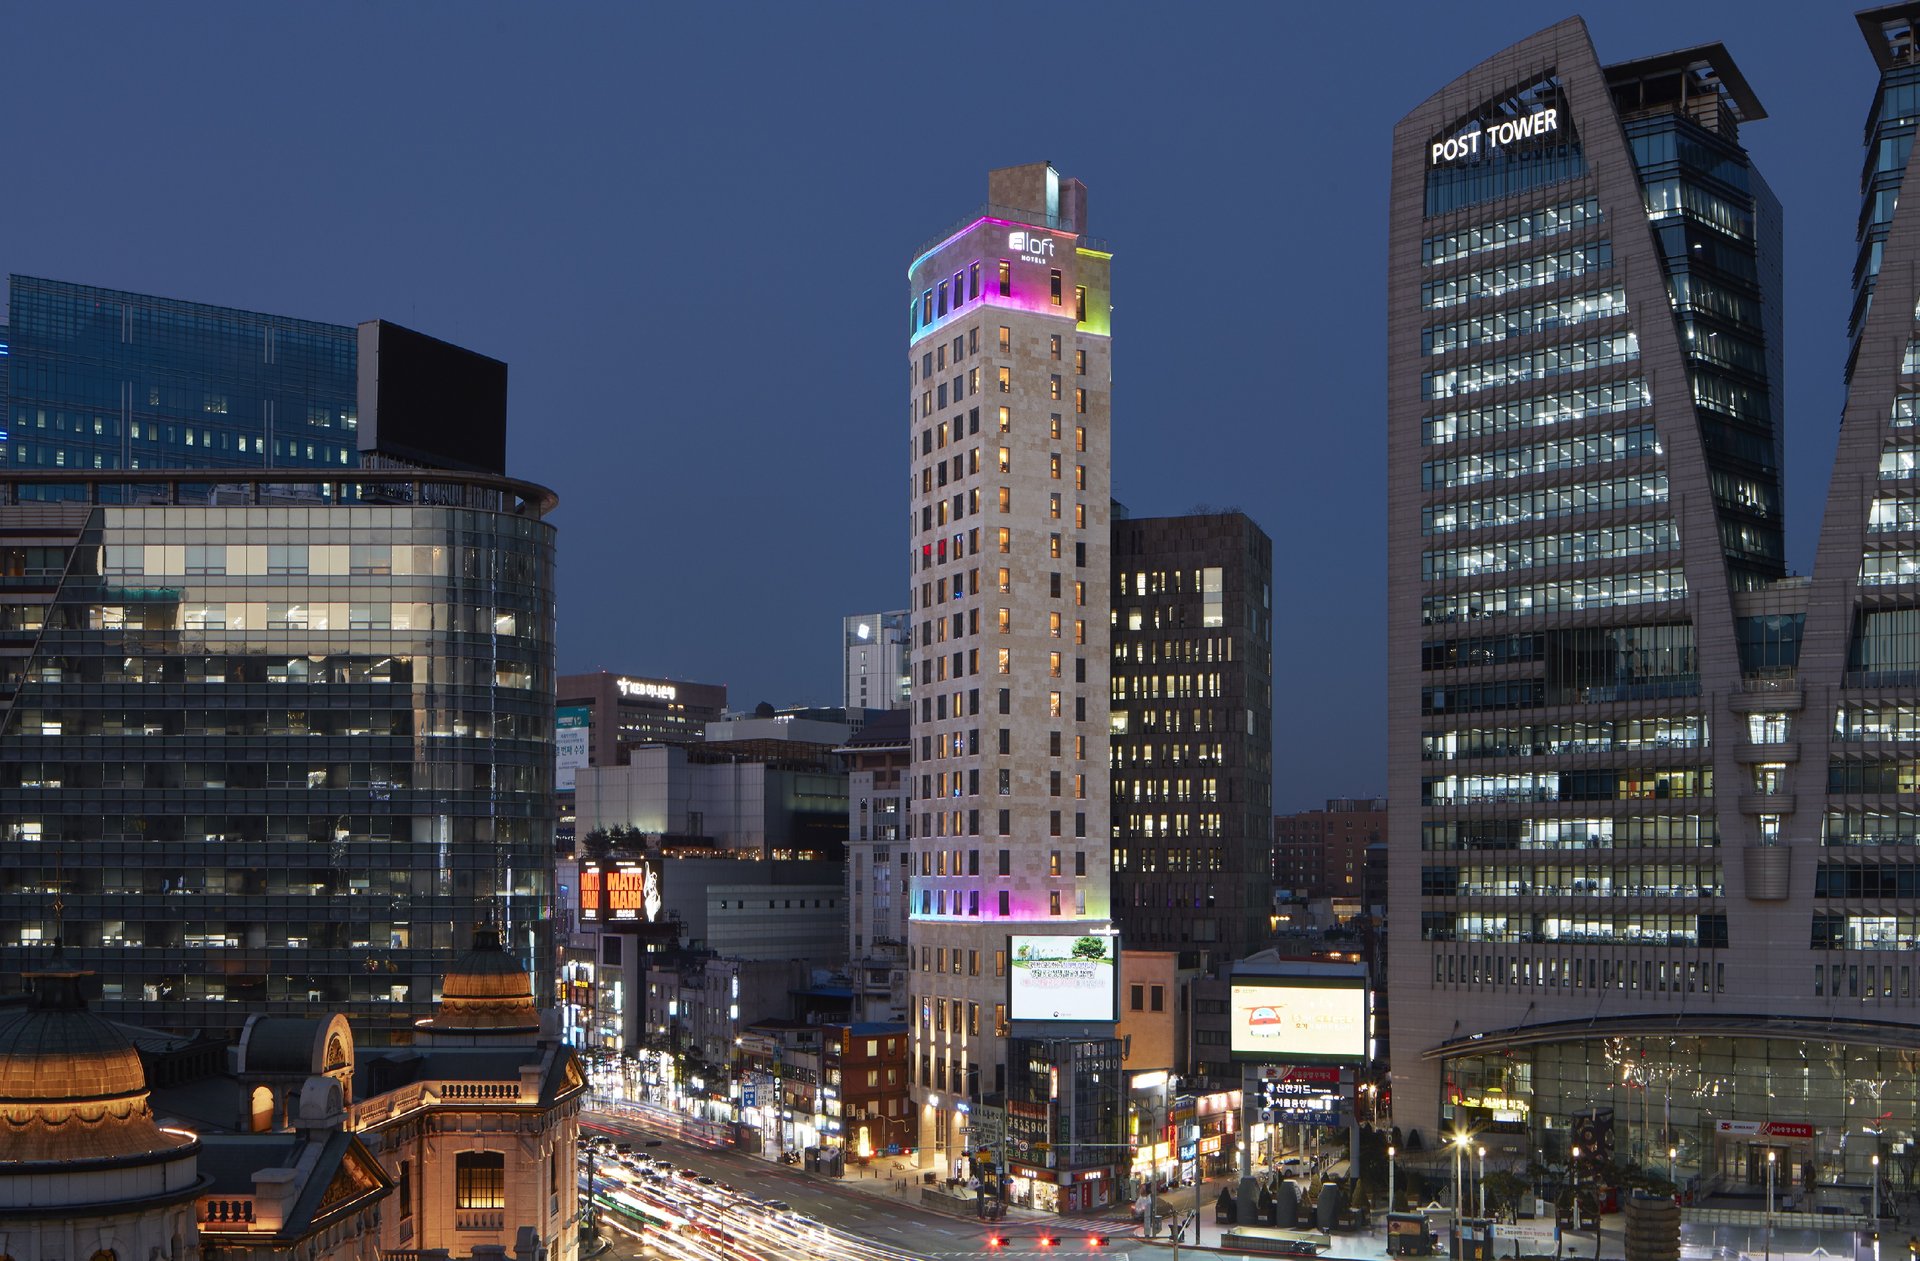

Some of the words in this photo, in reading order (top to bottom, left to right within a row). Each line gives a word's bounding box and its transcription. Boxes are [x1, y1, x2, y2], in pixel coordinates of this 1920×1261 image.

[1432, 131, 1482, 165] POST
[1487, 108, 1558, 148] TOWER
[1021, 254, 1046, 265] HOTELS
[609, 890, 642, 909] HARI
[1276, 1084, 1311, 1094] 신한카드
